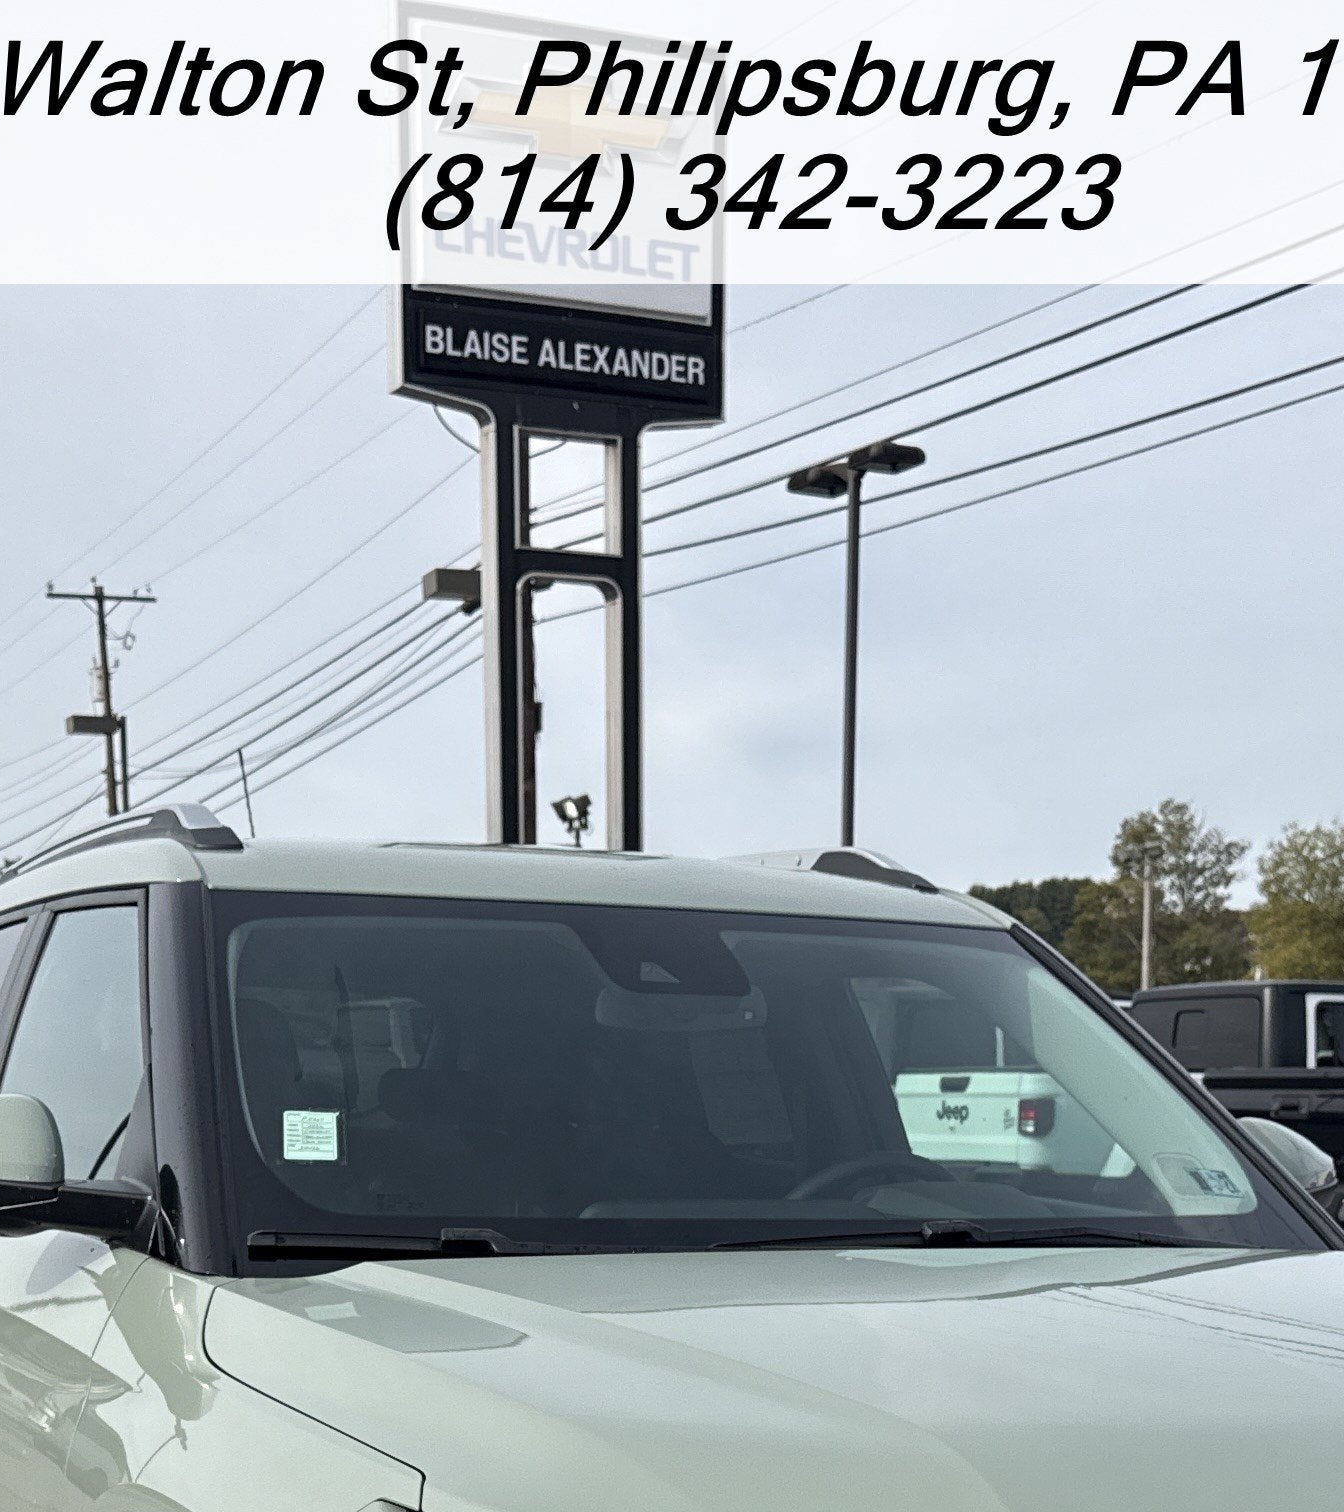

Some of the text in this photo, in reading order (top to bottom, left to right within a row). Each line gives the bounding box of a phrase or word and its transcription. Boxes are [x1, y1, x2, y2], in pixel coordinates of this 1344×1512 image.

[433, 211, 701, 283] CHEVROLET
[424, 324, 706, 386] BLAISE ALEXANDER
[936, 1099, 970, 1126] Jeep
